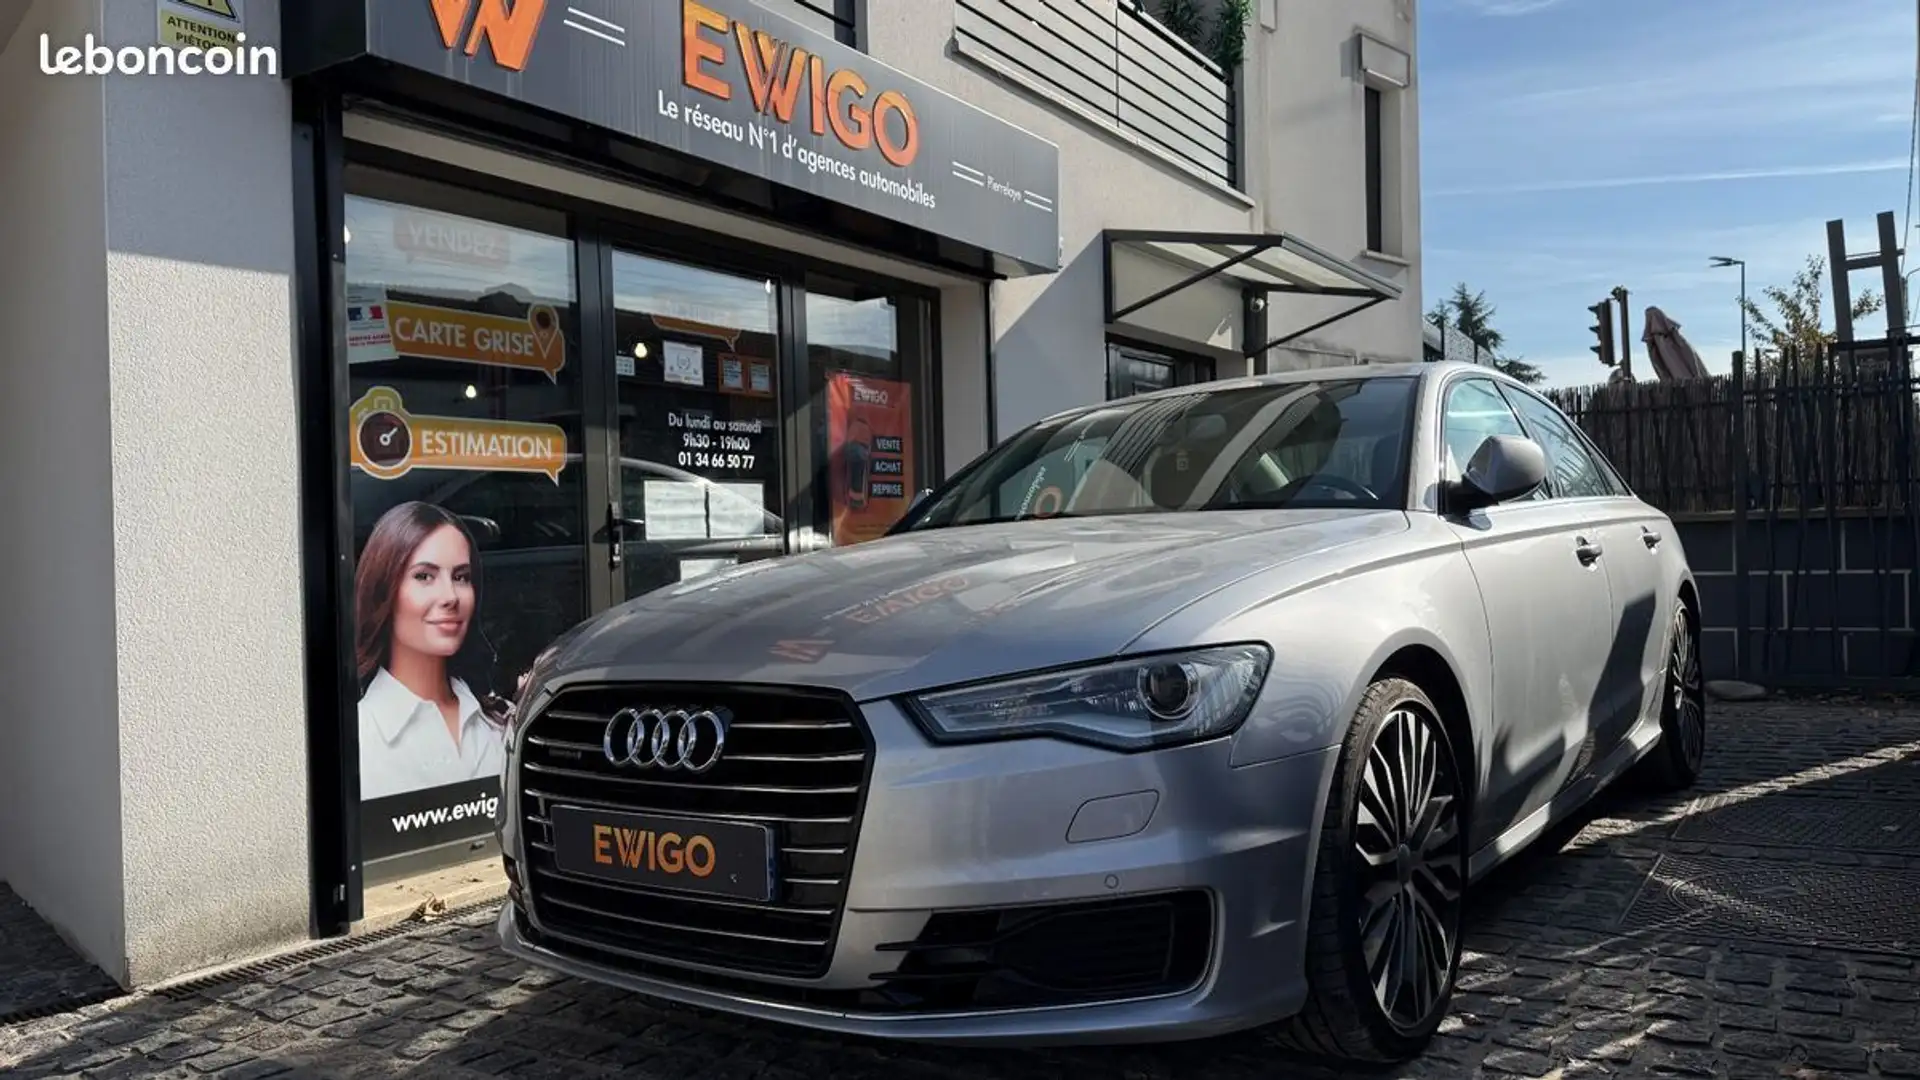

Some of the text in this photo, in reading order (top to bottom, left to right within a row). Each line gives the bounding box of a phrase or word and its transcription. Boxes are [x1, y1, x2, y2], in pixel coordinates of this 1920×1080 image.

[167, 16, 236, 44] ATTENTION
[683, 0, 919, 168] EWIGO
[657, 90, 678, 119] Le
[684, 102, 743, 142] réseau
[749, 122, 777, 154] N°1
[860, 169, 936, 210] automobiles
[408, 220, 498, 259] VENDEZ
[395, 316, 467, 348] CARTE
[473, 327, 535, 356] GRISE
[668, 412, 762, 434] Du lundi au samedi
[421, 430, 551, 460] ESTIMATION
[683, 432, 710, 448] 9h30
[720, 435, 750, 451] 19h00
[875, 437, 901, 451] VENTE
[678, 451, 755, 469] 01 34 66 50 77
[875, 460, 902, 473] ACHAT
[872, 483, 902, 496] REPRISE
[592, 823, 717, 878] EWIGO
